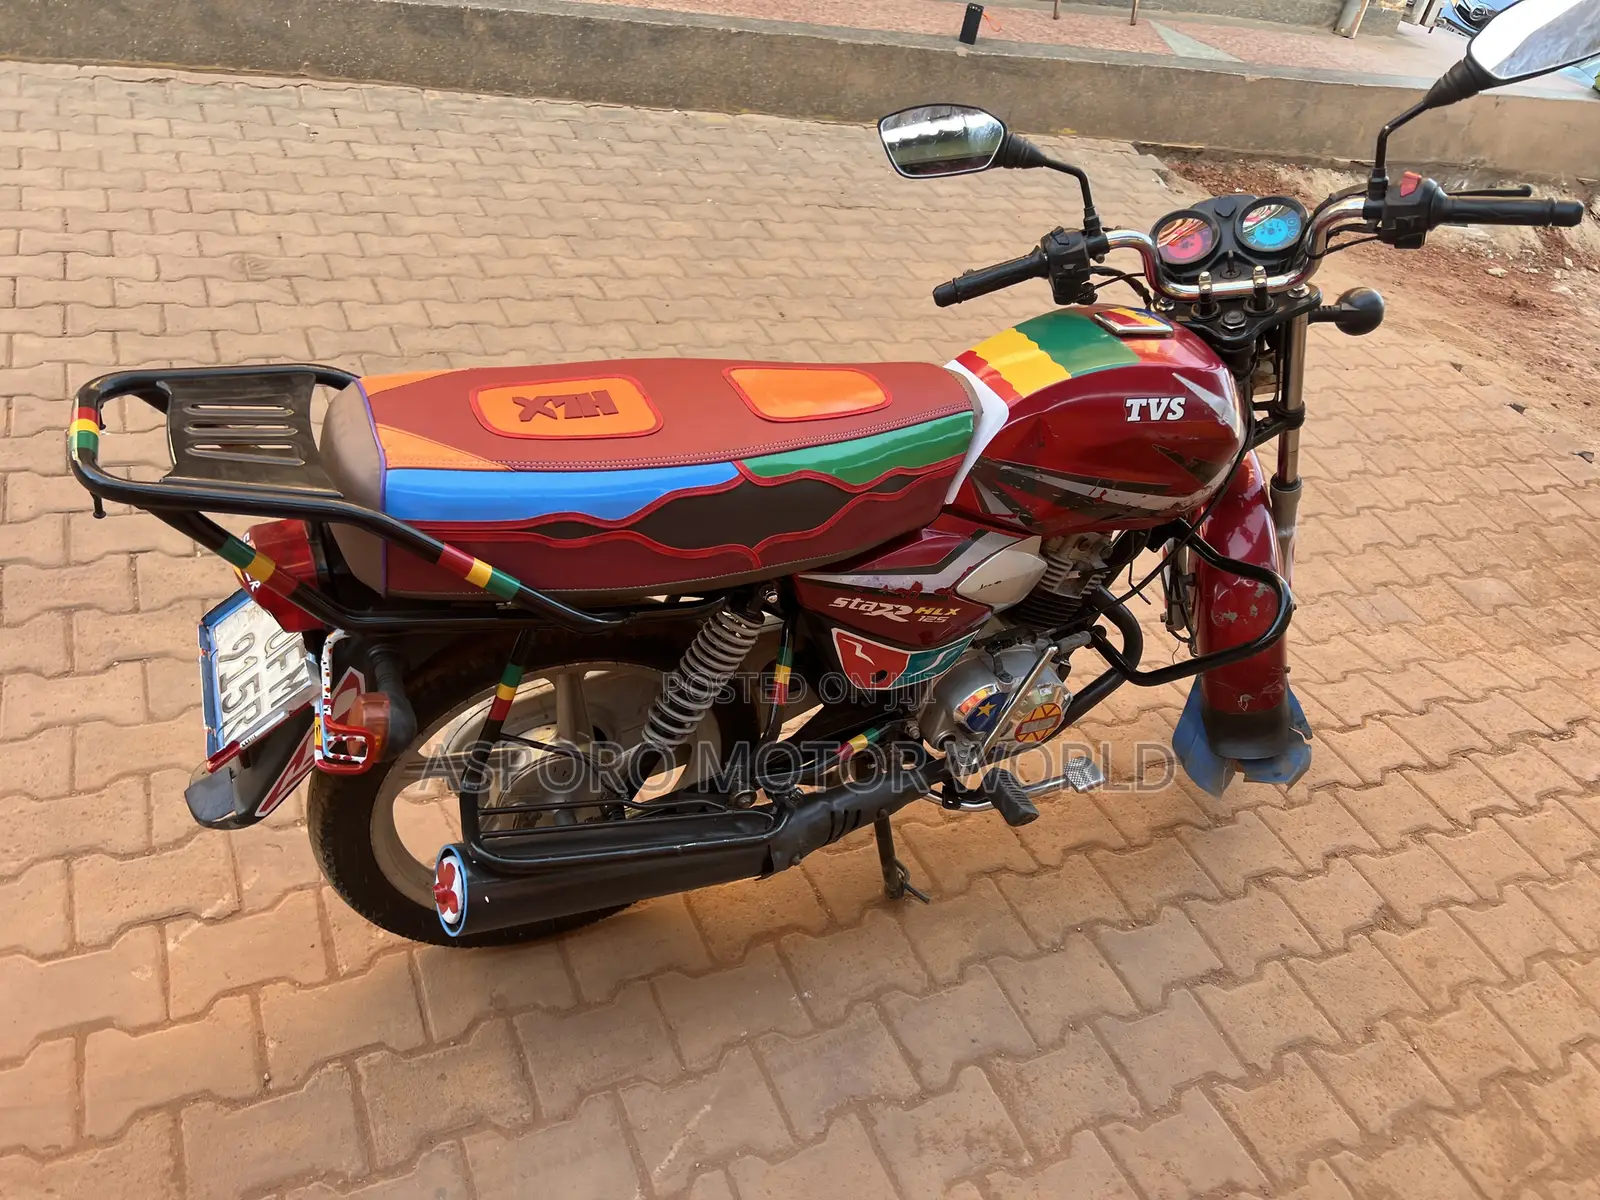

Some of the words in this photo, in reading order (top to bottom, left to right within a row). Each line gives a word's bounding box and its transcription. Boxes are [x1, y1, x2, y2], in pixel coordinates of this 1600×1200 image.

[512, 389, 619, 422] HLX
[1125, 397, 1186, 421] TVS
[914, 607, 961, 615] HLX
[918, 615, 949, 623] 125
